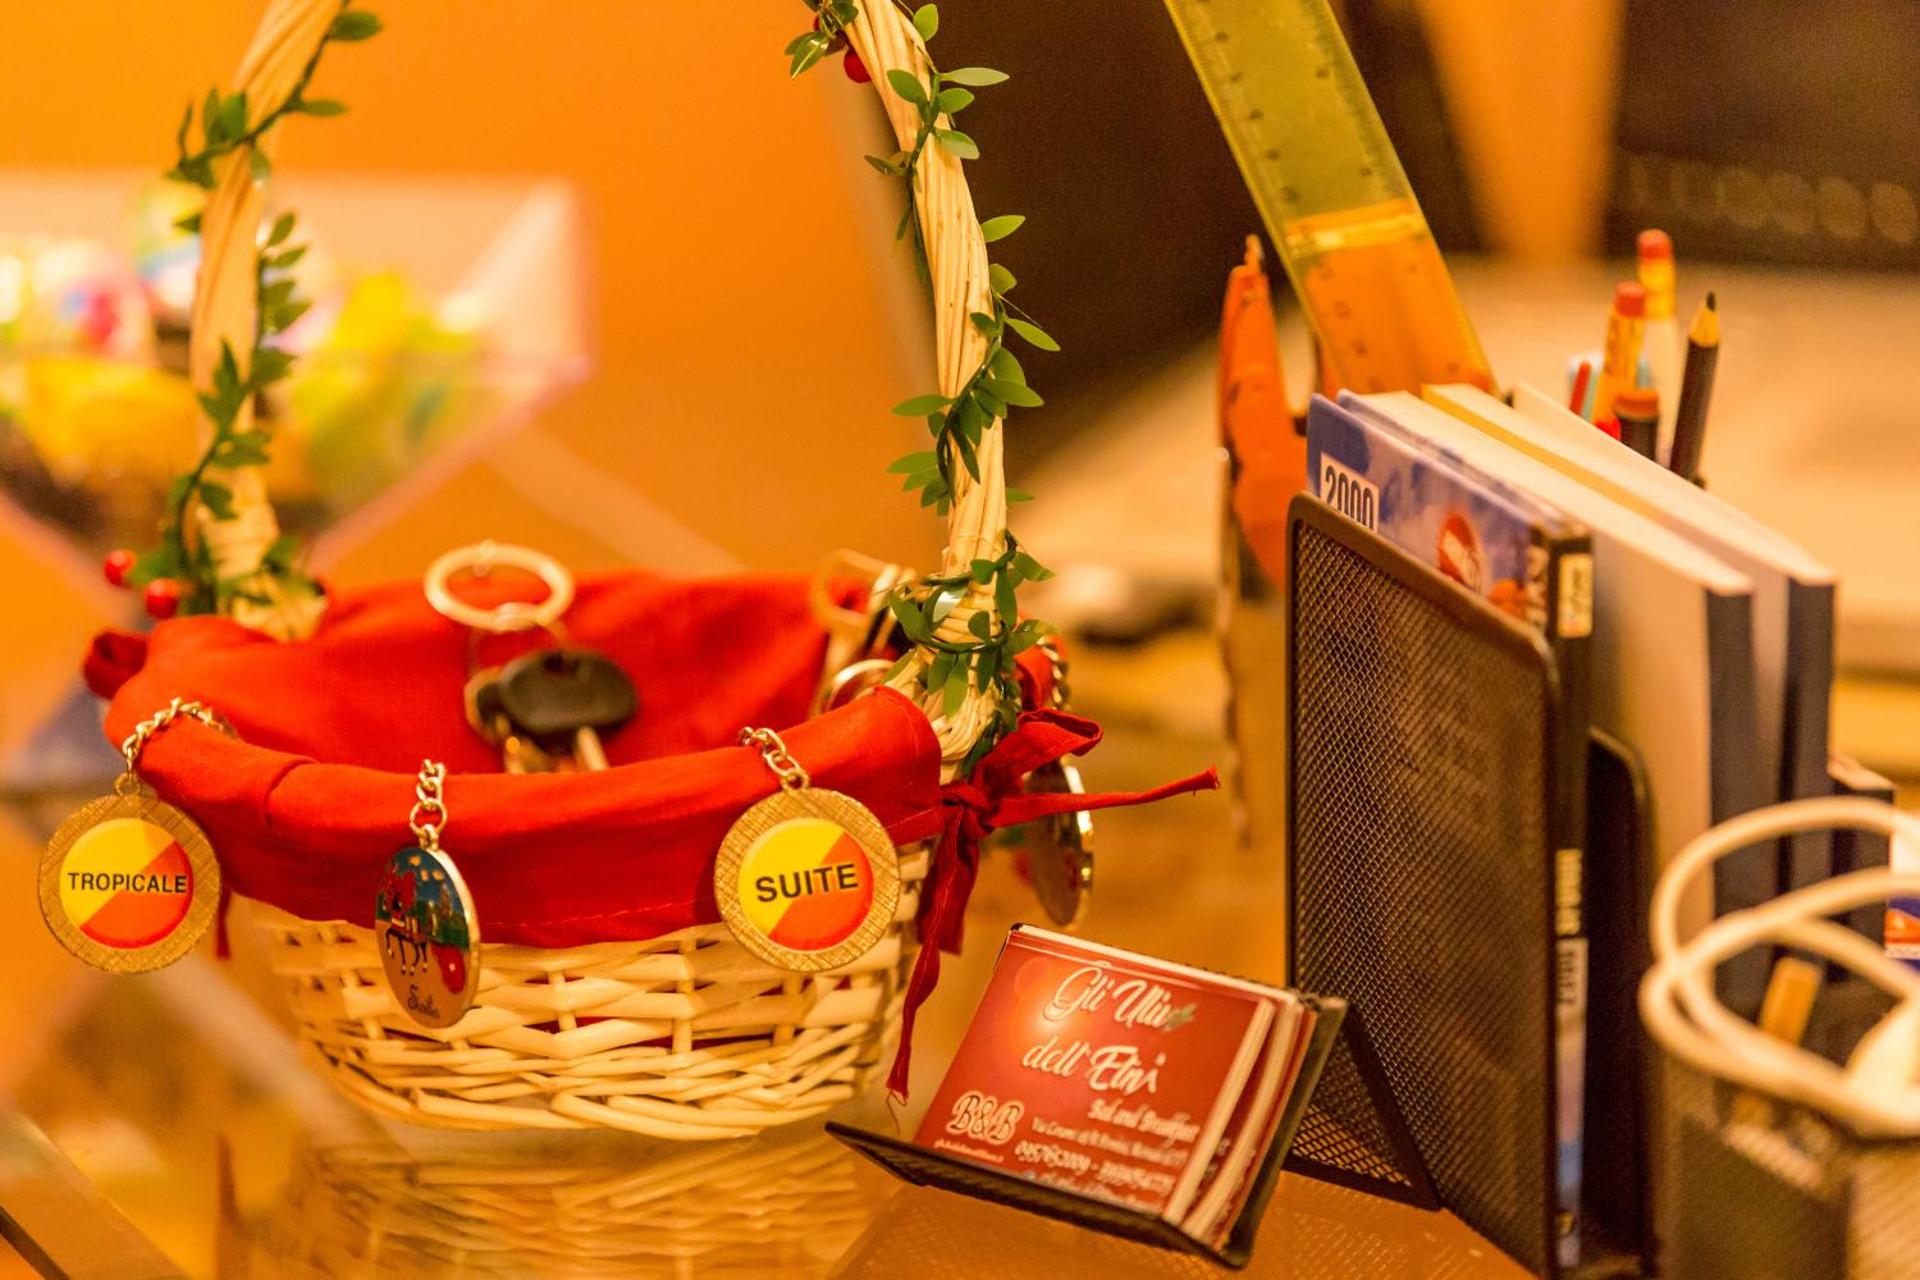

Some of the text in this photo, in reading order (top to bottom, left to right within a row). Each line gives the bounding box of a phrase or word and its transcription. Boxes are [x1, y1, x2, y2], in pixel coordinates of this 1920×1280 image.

[1325, 464, 1375, 531] 2000
[67, 872, 187, 893] TROPICALE
[754, 863, 859, 903] SUITE
[1043, 966, 1116, 1021] Gli
[946, 1091, 1024, 1144] B&B
